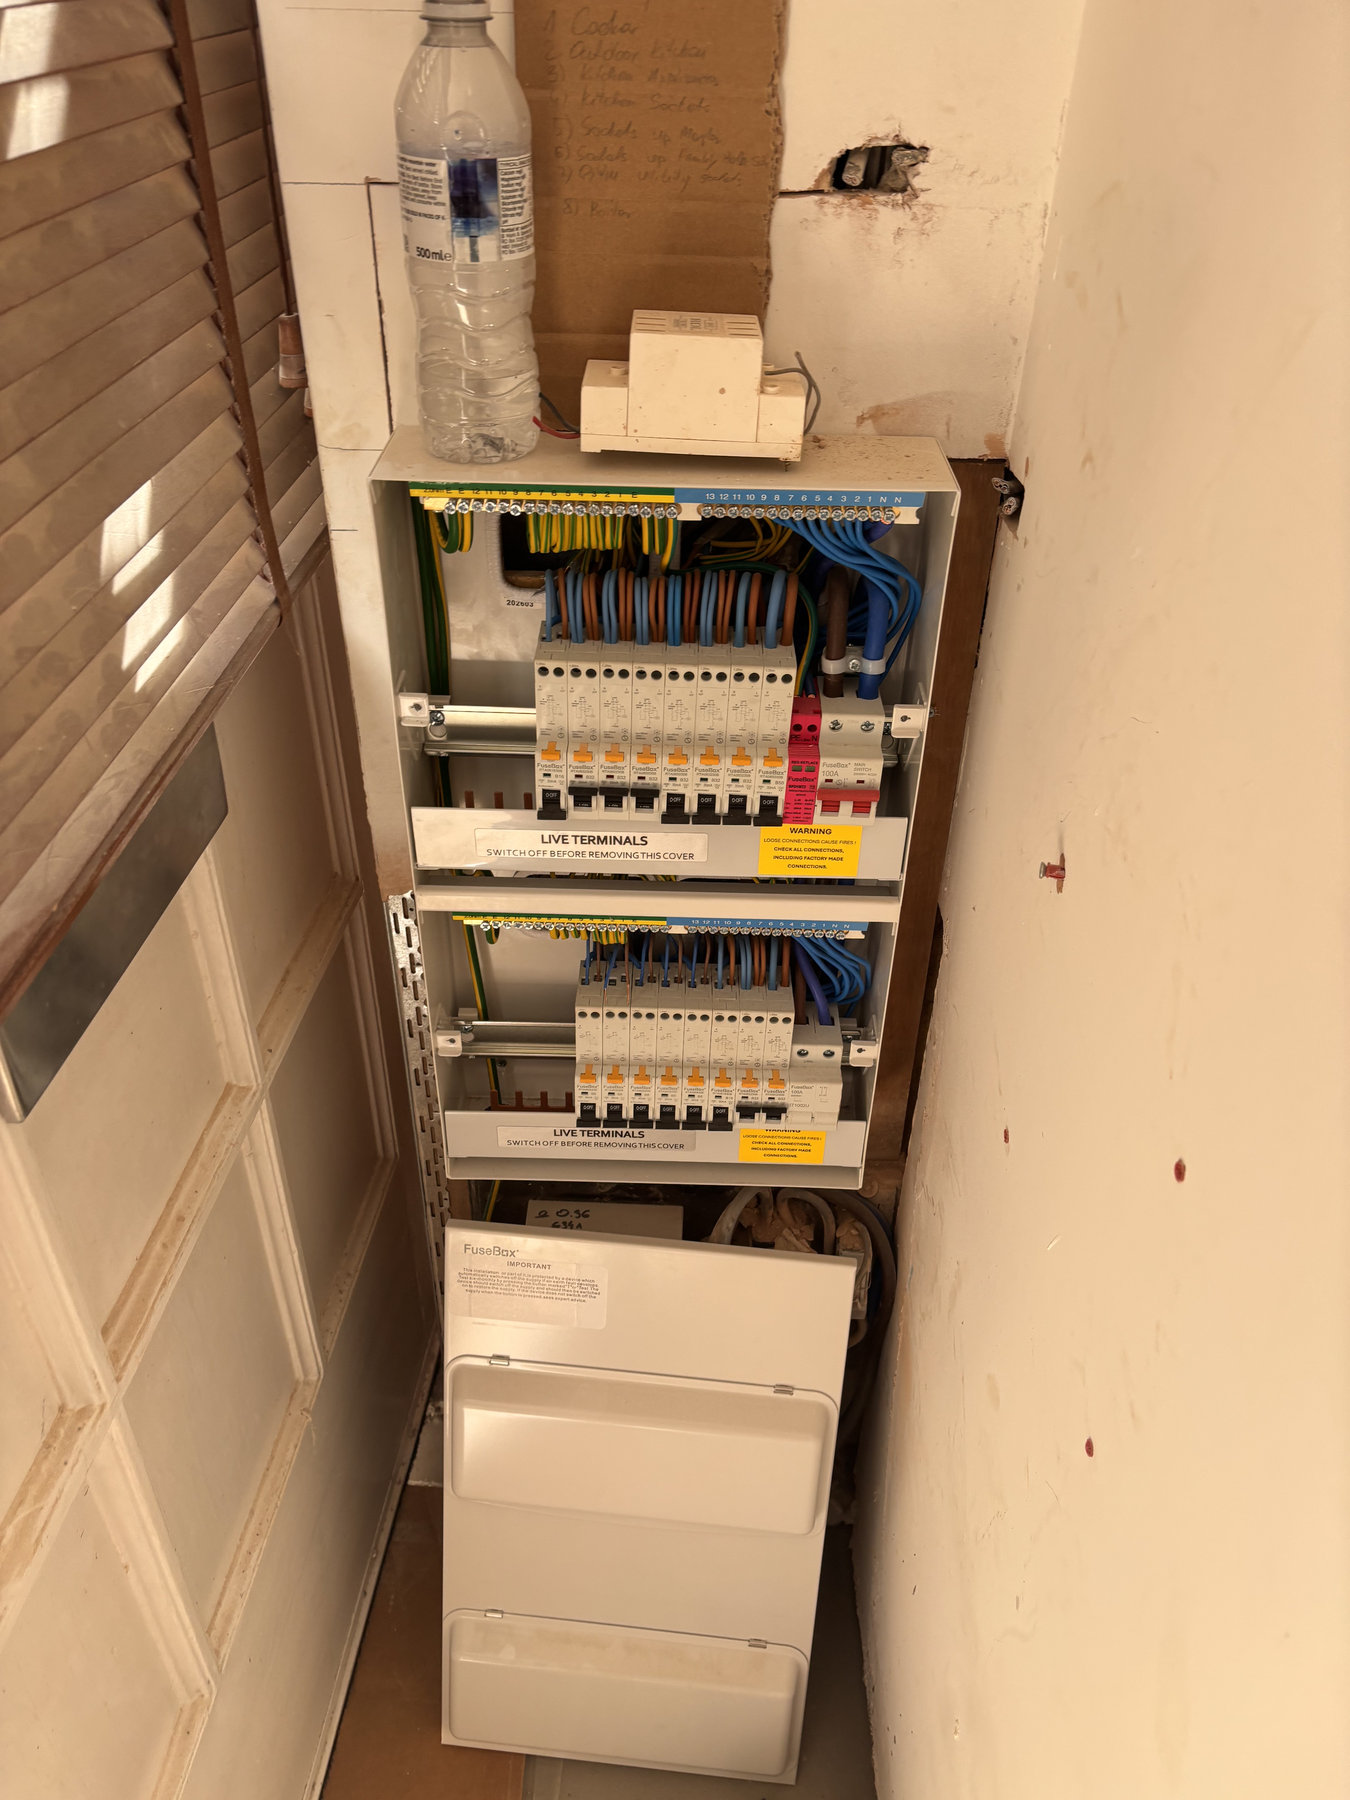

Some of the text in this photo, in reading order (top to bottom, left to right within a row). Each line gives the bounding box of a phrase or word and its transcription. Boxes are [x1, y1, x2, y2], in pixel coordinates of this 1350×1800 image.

[790, 827, 832, 835] WARNING
[540, 834, 648, 846] LIVE TERMINALS
[486, 848, 694, 860] SWITCH OFF BEFORE REMOVING THIS COVER
[553, 1128, 645, 1138] LIVE TERMINALS
[594, 1141, 638, 1149] REMOVING
[464, 1243, 516, 1258] FuseBox
[506, 1260, 552, 1270] IMPORTANT
